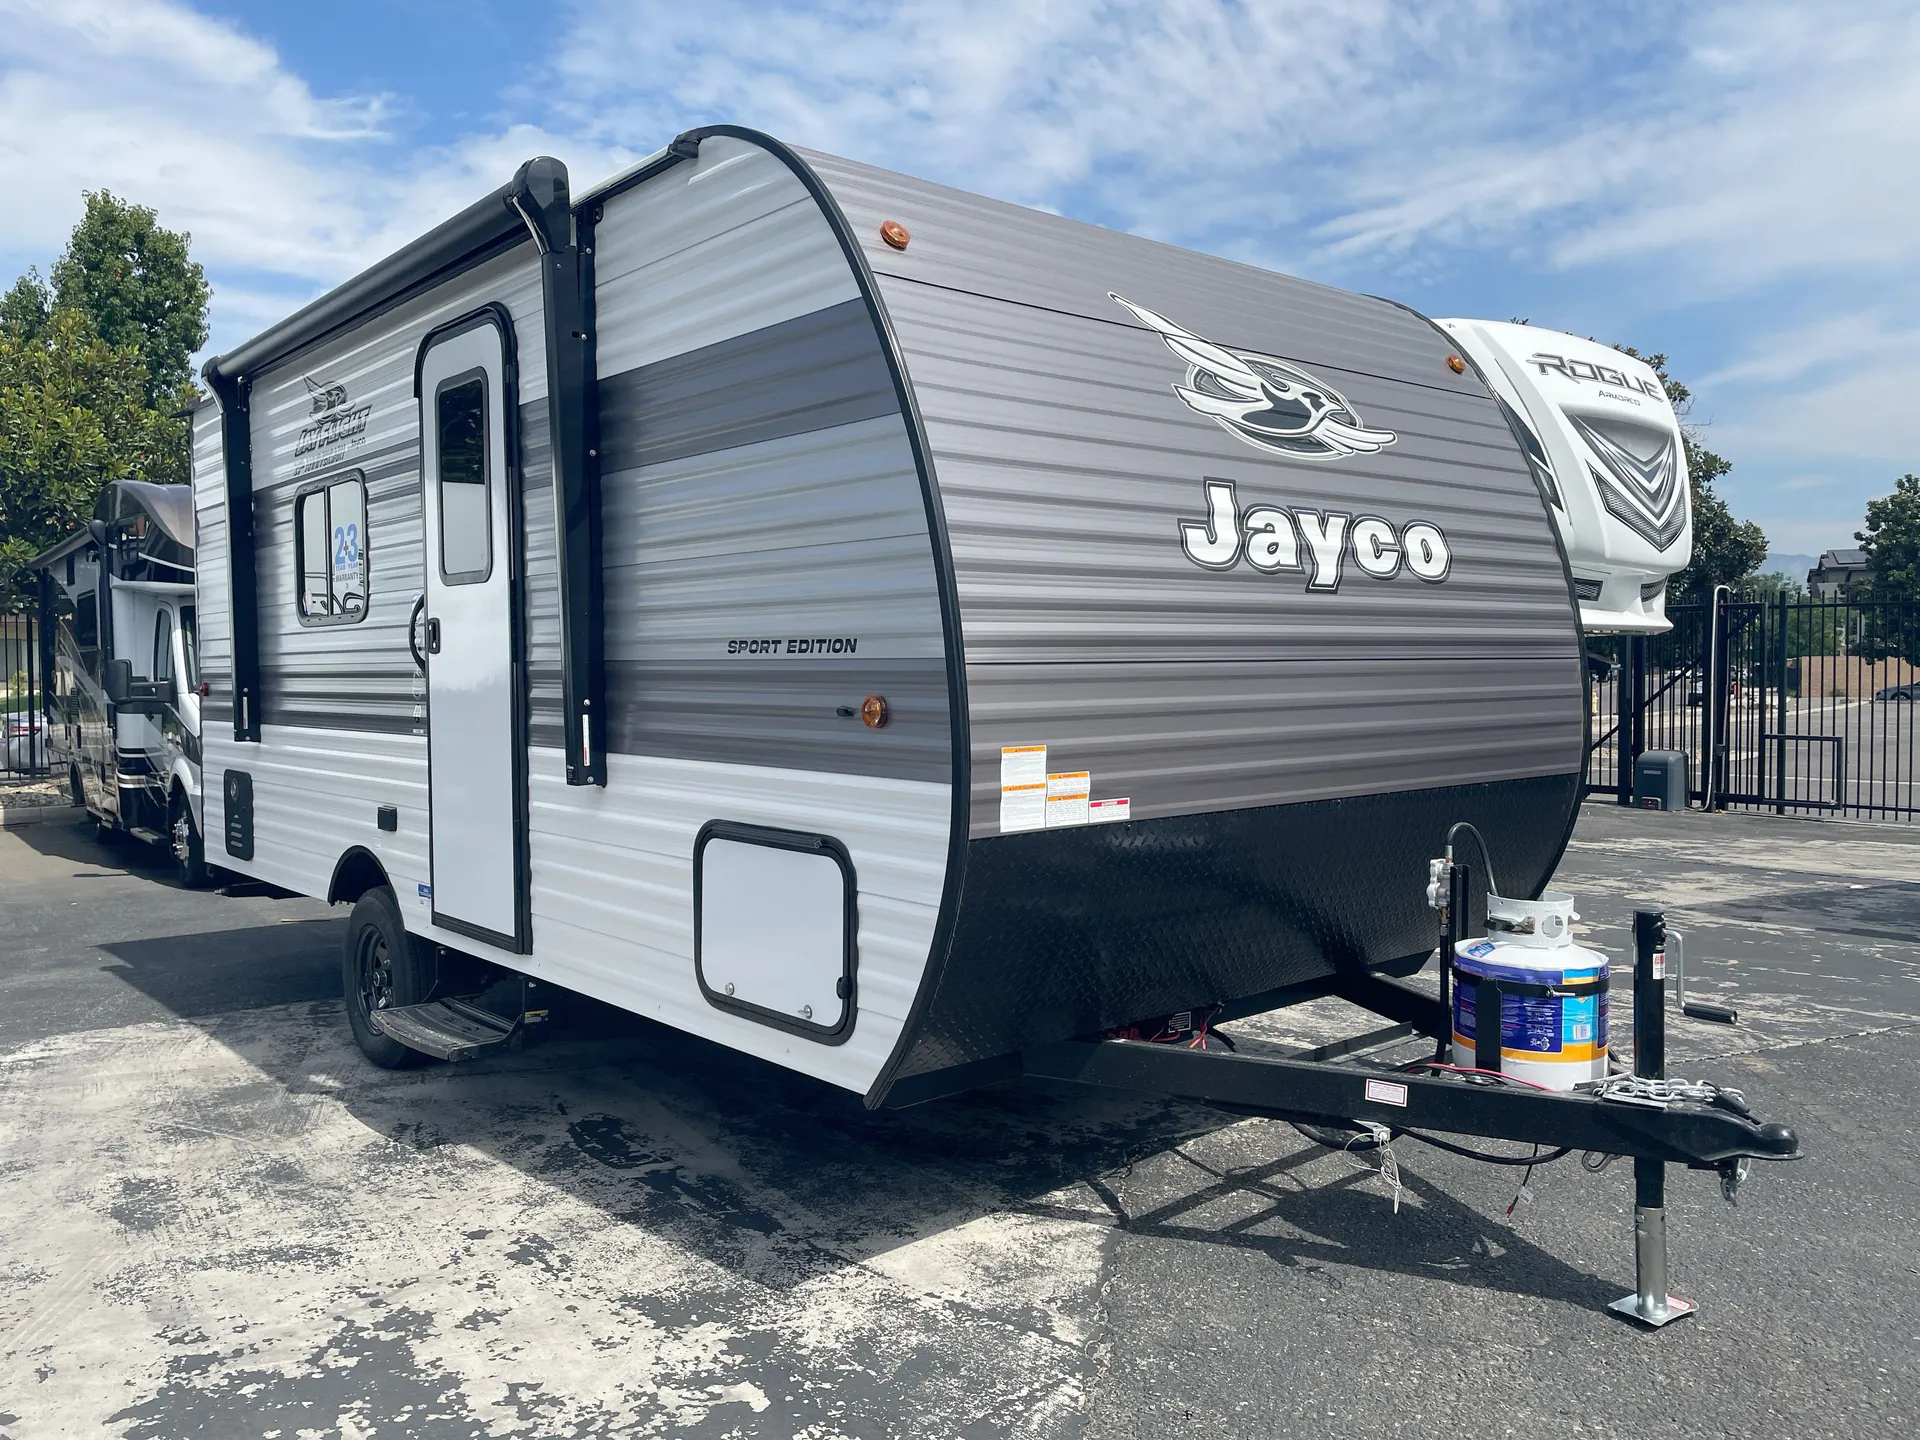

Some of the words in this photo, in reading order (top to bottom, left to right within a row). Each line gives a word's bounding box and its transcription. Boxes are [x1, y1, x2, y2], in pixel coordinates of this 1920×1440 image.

[1526, 352, 1664, 403] ROGUE
[318, 404, 373, 448] FLIGHT
[1177, 476, 1453, 594] Jayco
[336, 571, 359, 582] WARRANTY
[727, 639, 782, 654] SPORT
[786, 638, 858, 654] EDITION
